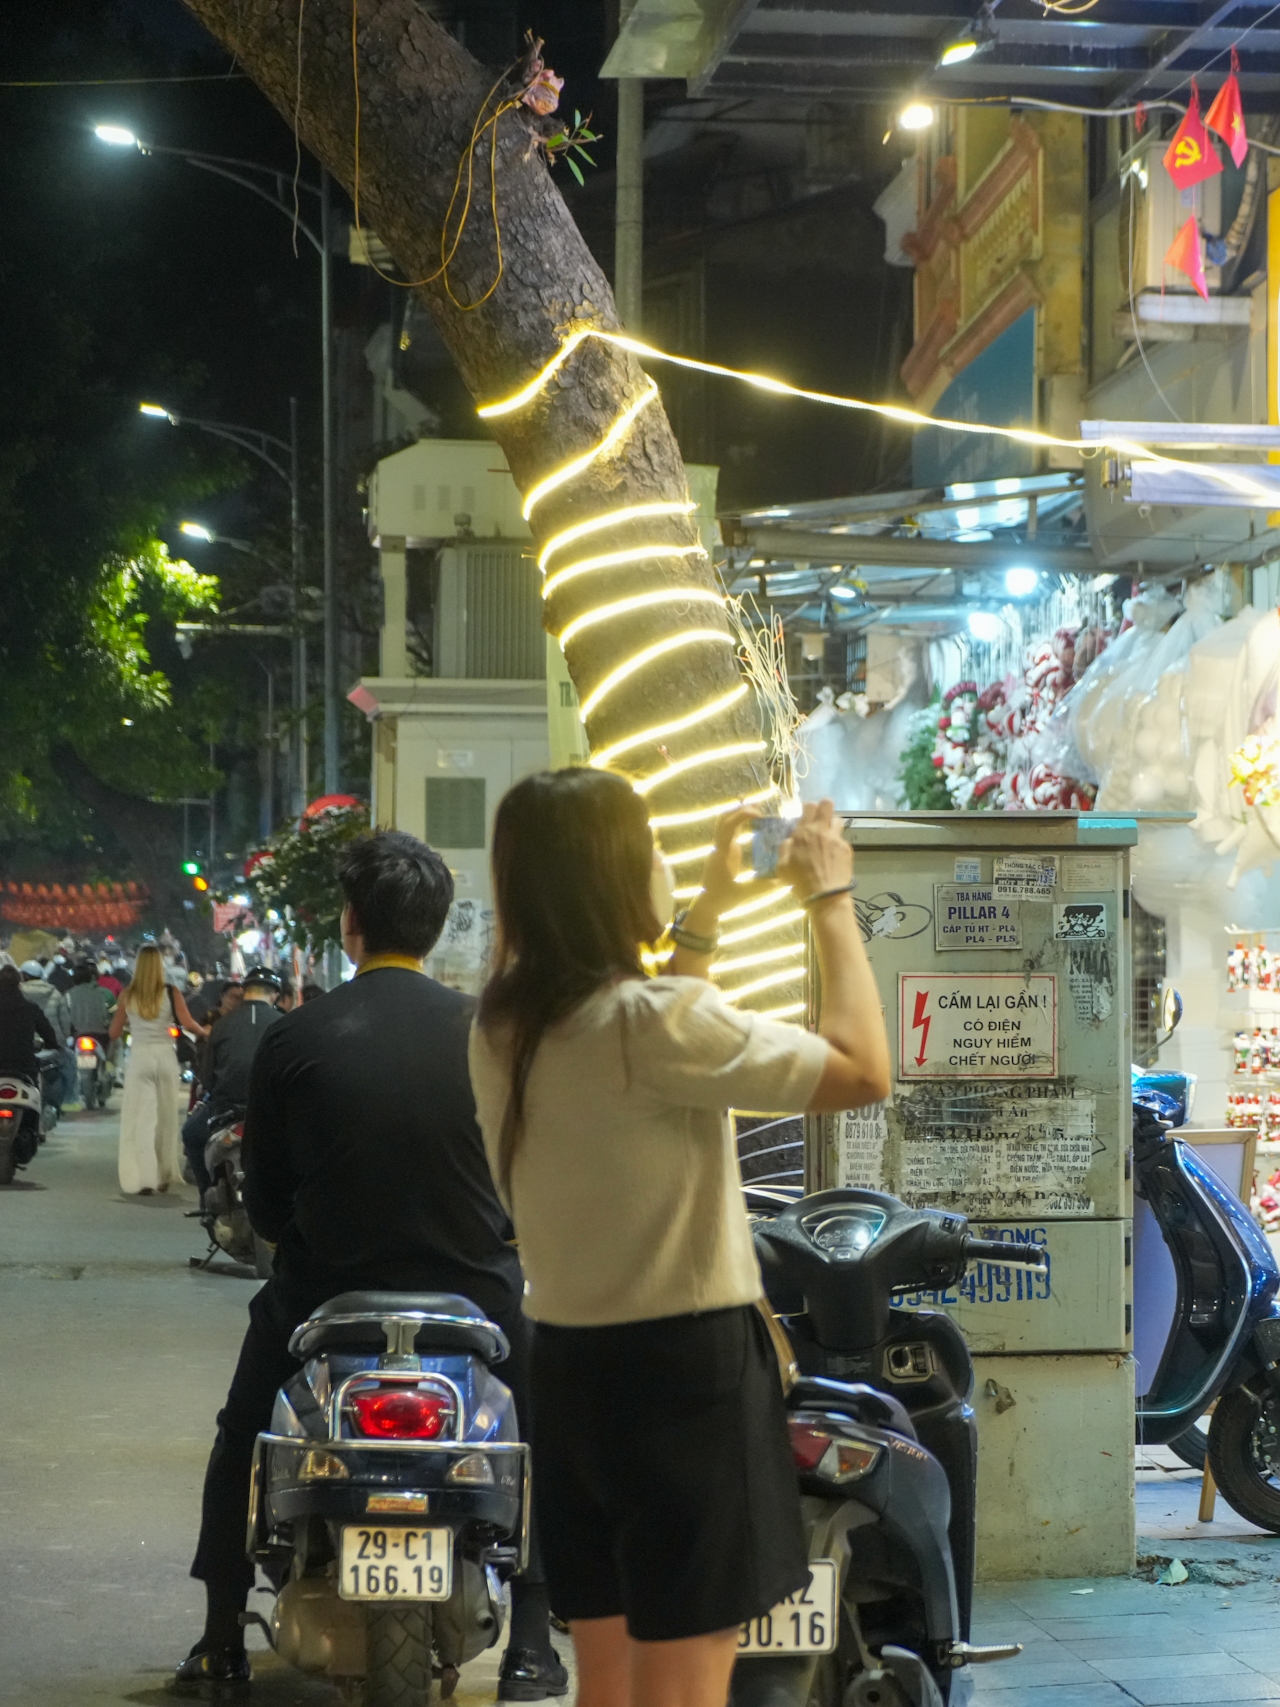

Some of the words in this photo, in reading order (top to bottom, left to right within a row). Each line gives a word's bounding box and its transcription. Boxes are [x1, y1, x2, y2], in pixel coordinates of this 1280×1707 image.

[956, 892, 970, 901] TBA
[972, 890, 992, 901] HÀNG
[948, 906, 997, 920] PILLAR
[1001, 906, 1010, 919] 4
[978, 925, 990, 933] HT
[999, 925, 1016, 933] PL4
[965, 935, 984, 943] PL4
[996, 935, 1016, 943] PL5
[938, 990, 973, 1009] CẤM
[976, 996, 1001, 1011] LẠI
[1005, 989, 1039, 1009] GẦN
[963, 1017, 984, 1031] CÓ
[987, 1020, 1021, 1034] ĐIỆN
[952, 1038, 993, 1049] NGUY
[997, 1032, 1032, 1048] HIỂM
[949, 1050, 986, 1066] CHẾT
[990, 1052, 1036, 1066] NGƯỜI
[357, 1531, 434, 1561] 29-C1
[350, 1566, 444, 1594] 166.19
